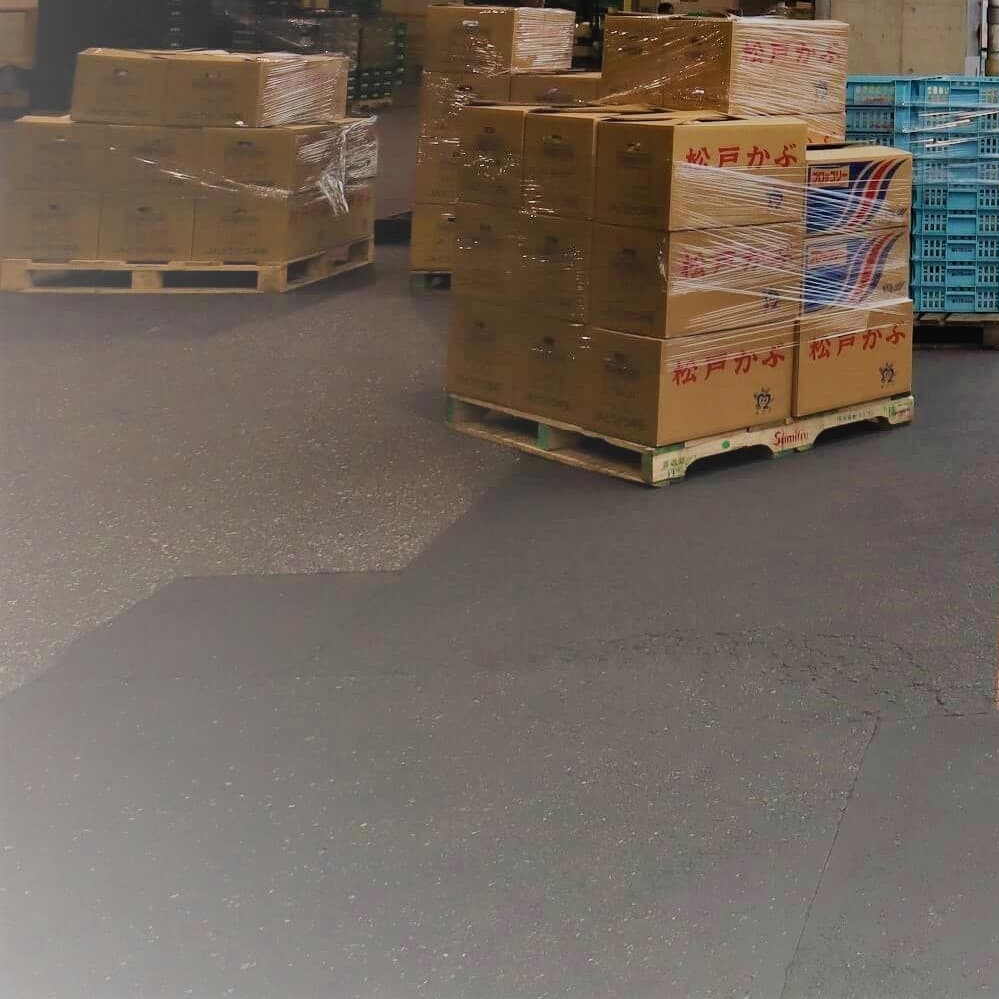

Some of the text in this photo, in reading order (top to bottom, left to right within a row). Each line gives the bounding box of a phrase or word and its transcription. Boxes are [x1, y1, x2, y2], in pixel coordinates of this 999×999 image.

[685, 143, 797, 168] 松戸かぶ
[807, 319, 905, 360] 松戸かぶ
[671, 344, 785, 386] 松戸かぶ
